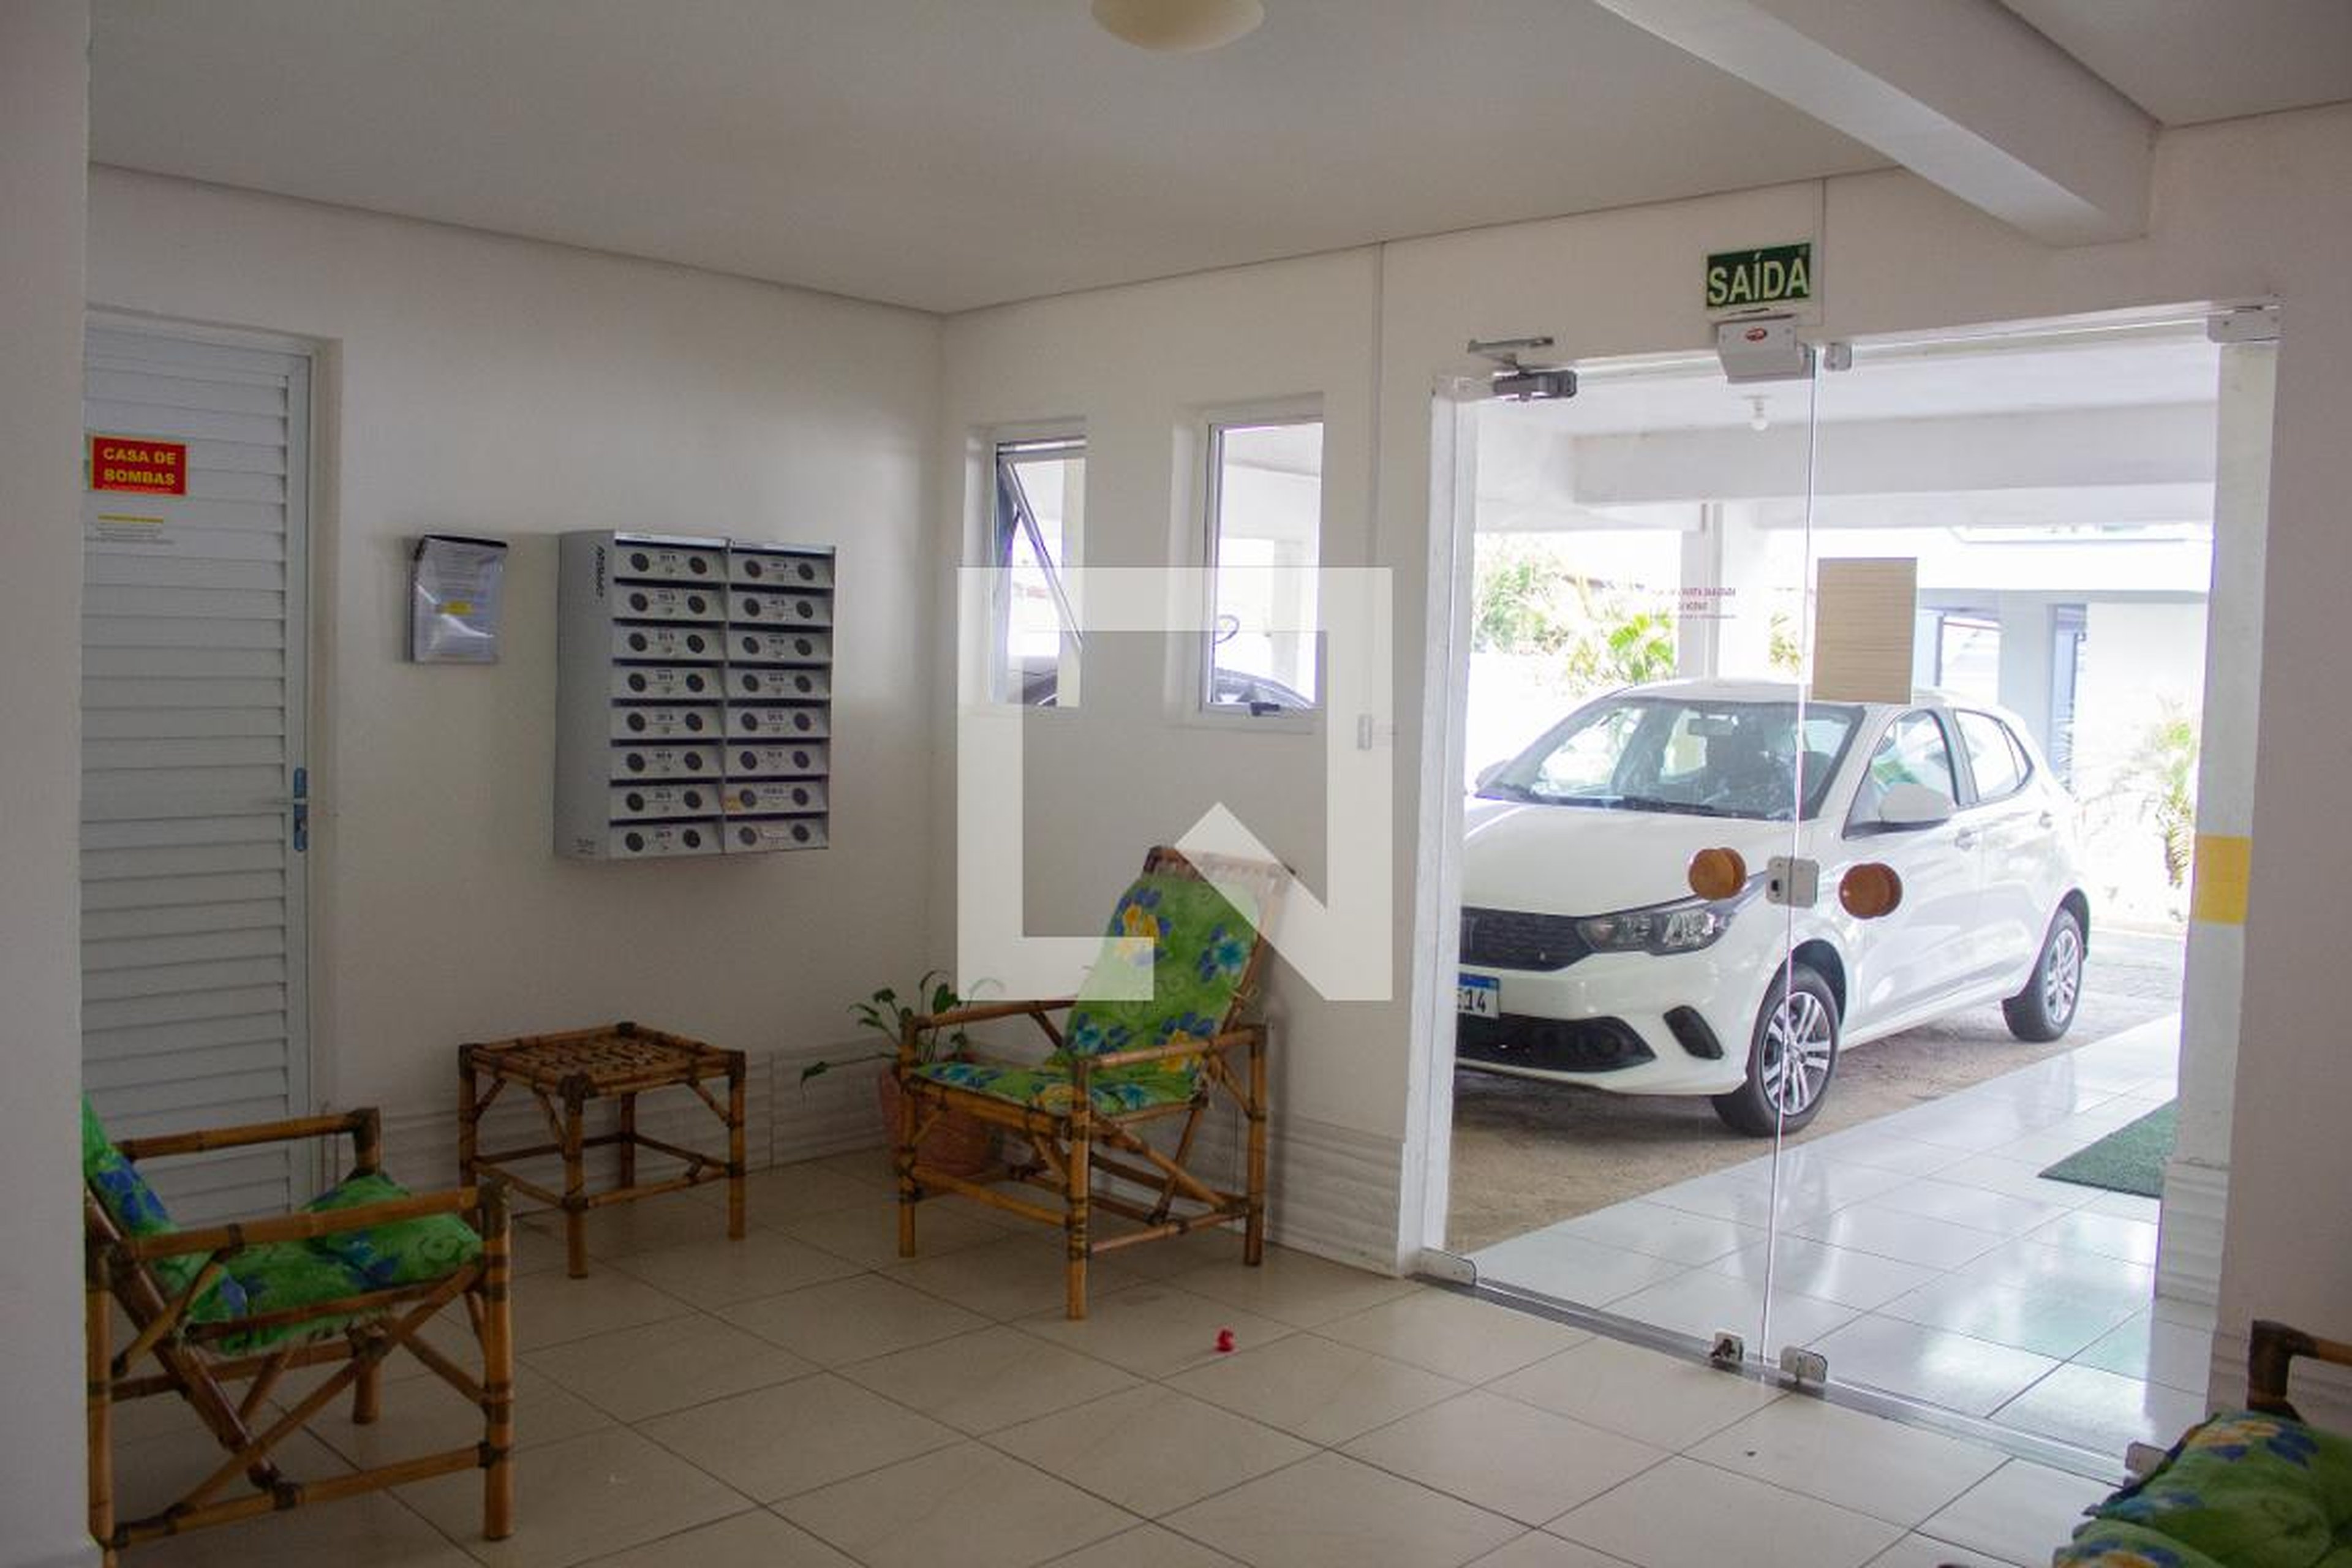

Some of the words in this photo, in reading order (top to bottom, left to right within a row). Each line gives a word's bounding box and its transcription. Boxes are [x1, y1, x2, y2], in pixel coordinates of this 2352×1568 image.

[1708, 252, 1809, 304] SAÍDA
[103, 448, 149, 462] CASA
[154, 451, 176, 465] DE
[104, 469, 175, 485] BOMBAS
